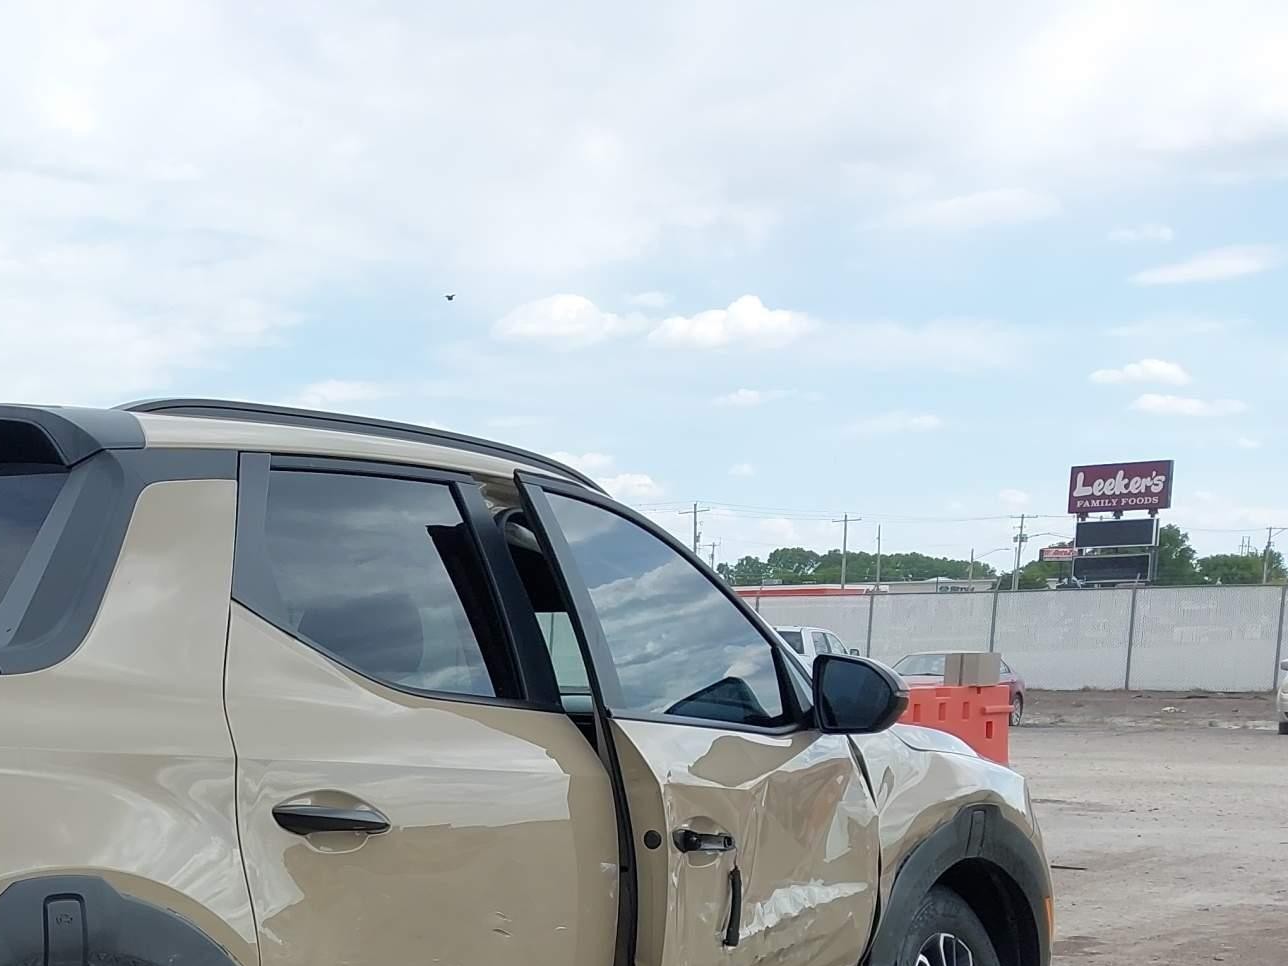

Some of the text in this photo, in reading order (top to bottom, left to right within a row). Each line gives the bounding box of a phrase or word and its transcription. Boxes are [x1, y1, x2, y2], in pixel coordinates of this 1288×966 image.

[1073, 470, 1166, 497] Leeker's
[1076, 496, 1159, 508] FAMILY FOODS
